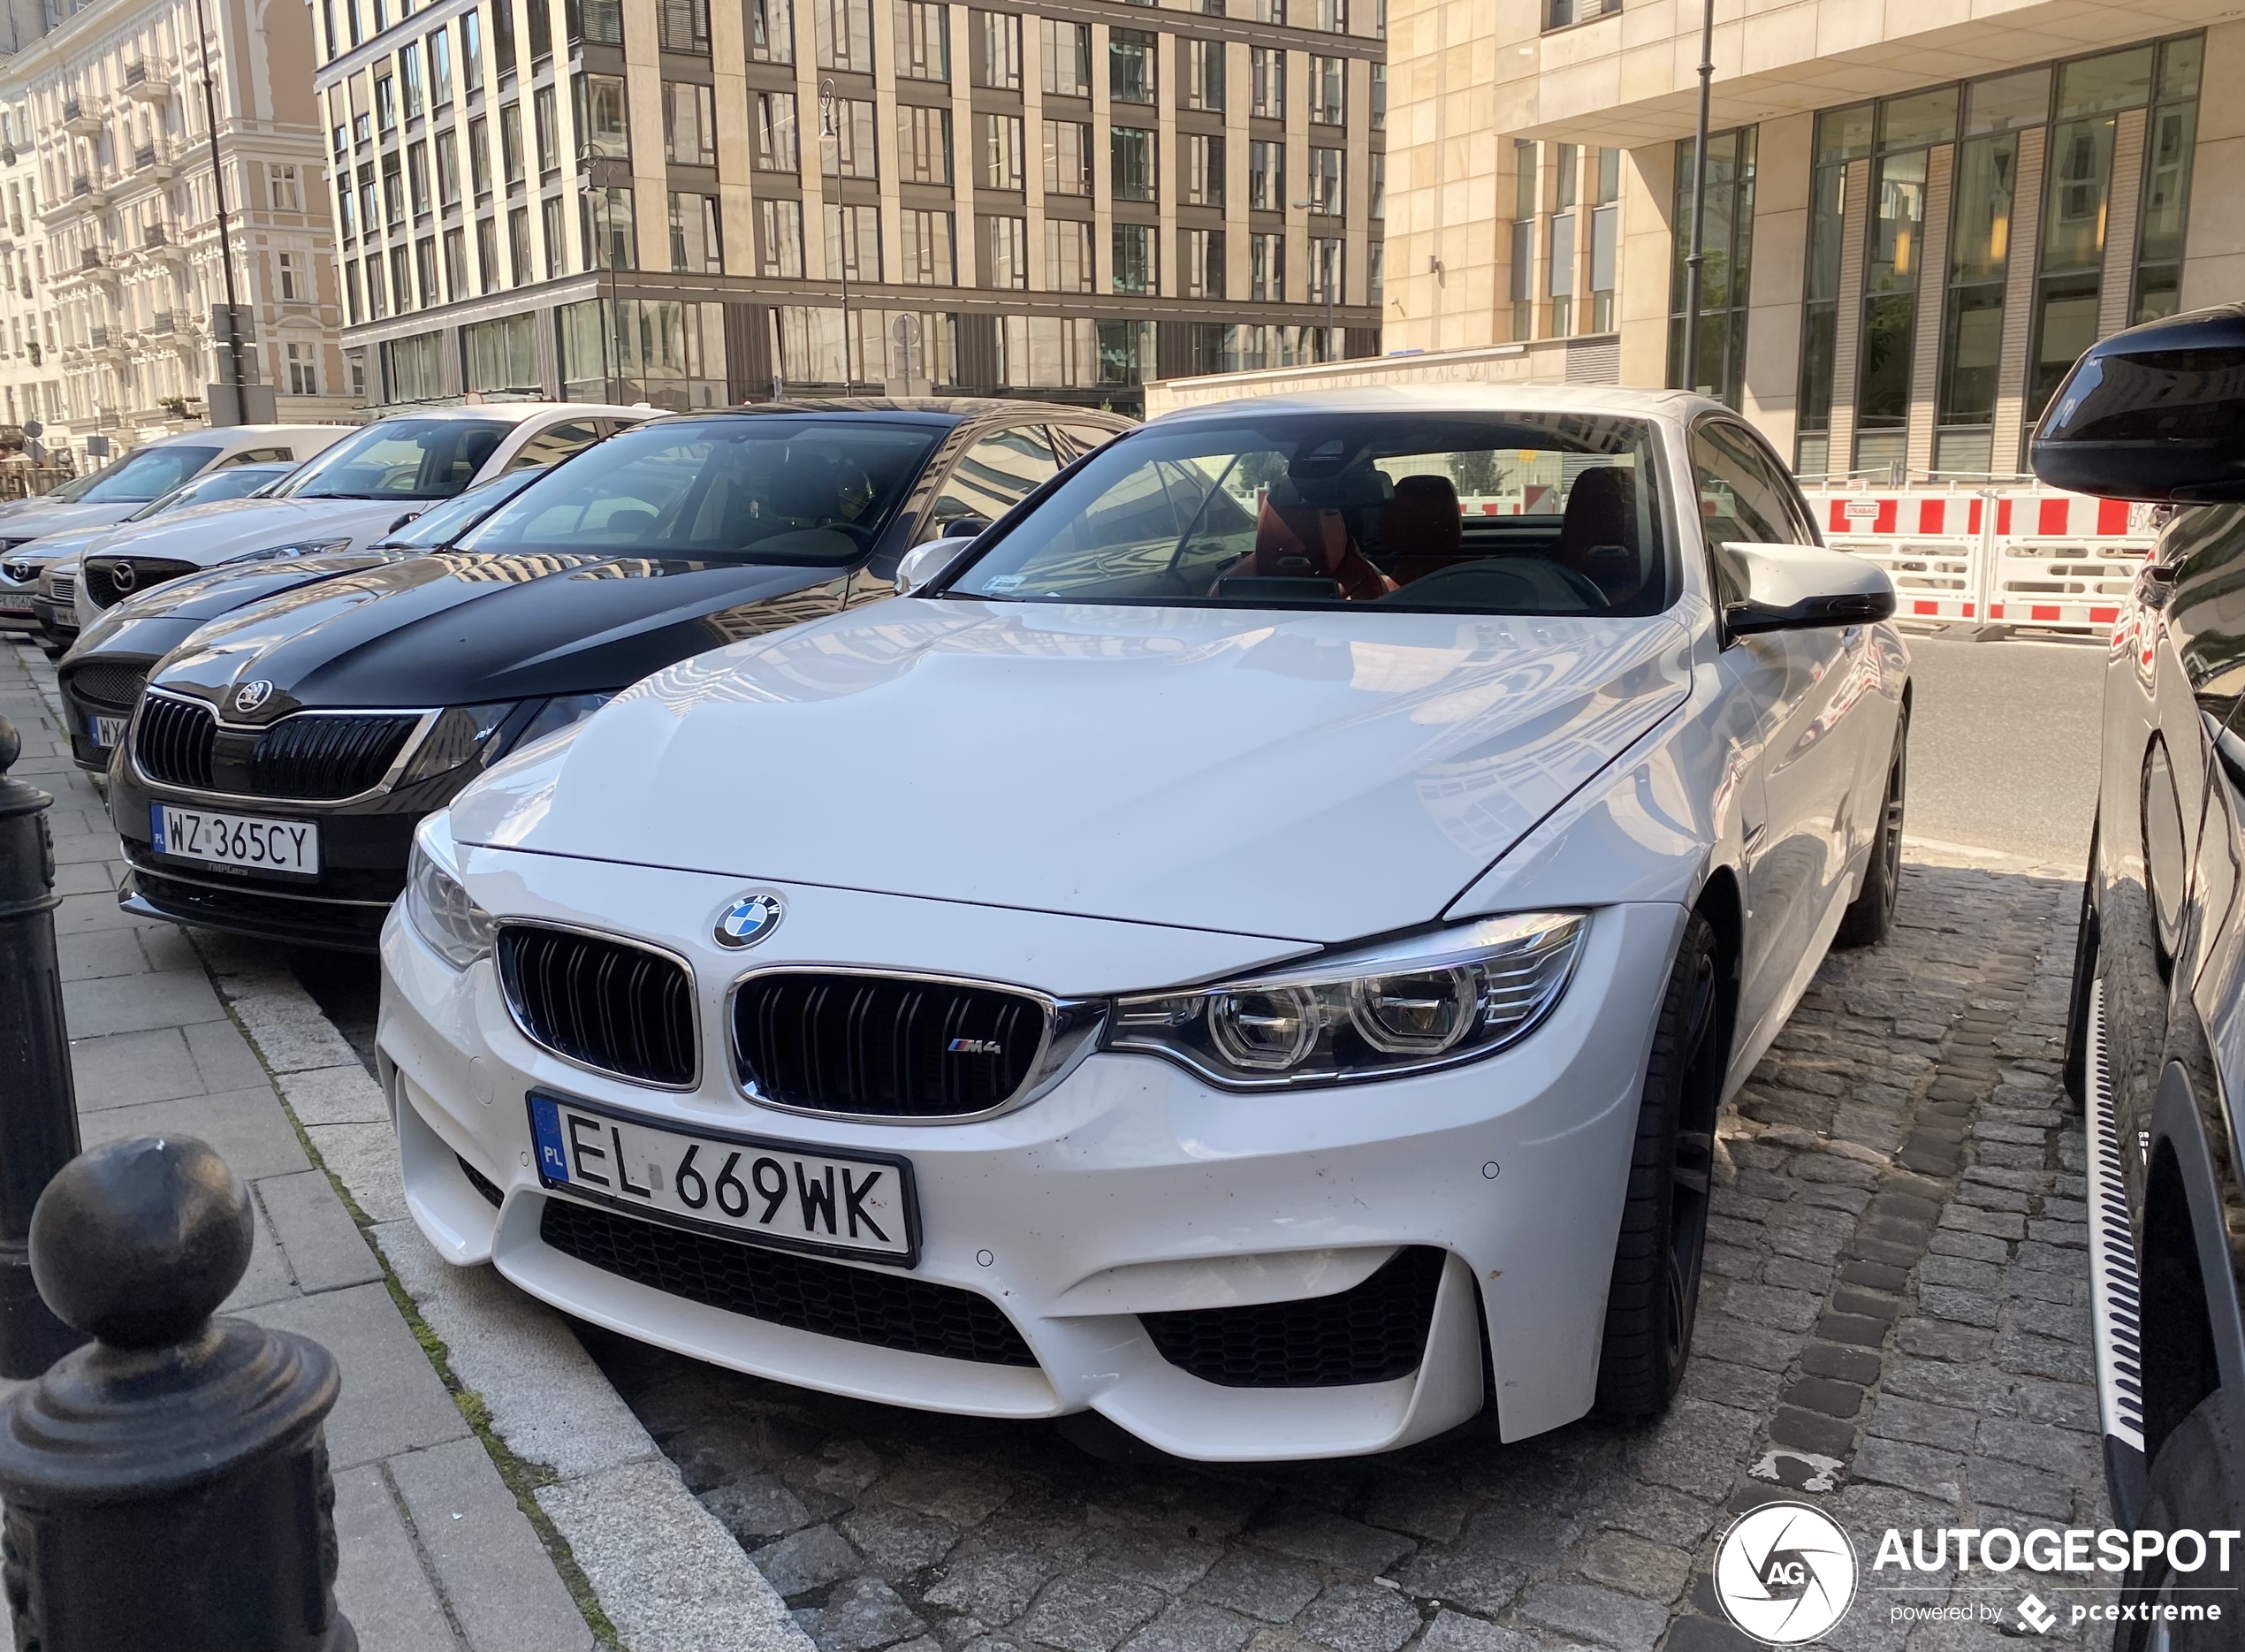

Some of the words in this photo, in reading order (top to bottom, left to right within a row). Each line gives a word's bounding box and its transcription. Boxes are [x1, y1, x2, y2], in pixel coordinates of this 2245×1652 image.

[1172, 385, 1253, 403] NACZELNY
[1317, 359, 1520, 390] ADMINISTRACYJNY
[100, 719, 120, 744] WY
[155, 833, 164, 845] PL
[168, 811, 202, 854] WZ
[213, 818, 307, 867] 365CY
[733, 895, 780, 915] BMW
[962, 1038, 1001, 1054] M4
[544, 1146, 564, 1168] PL
[567, 1113, 651, 1199] EL
[675, 1144, 892, 1243] 669WK
